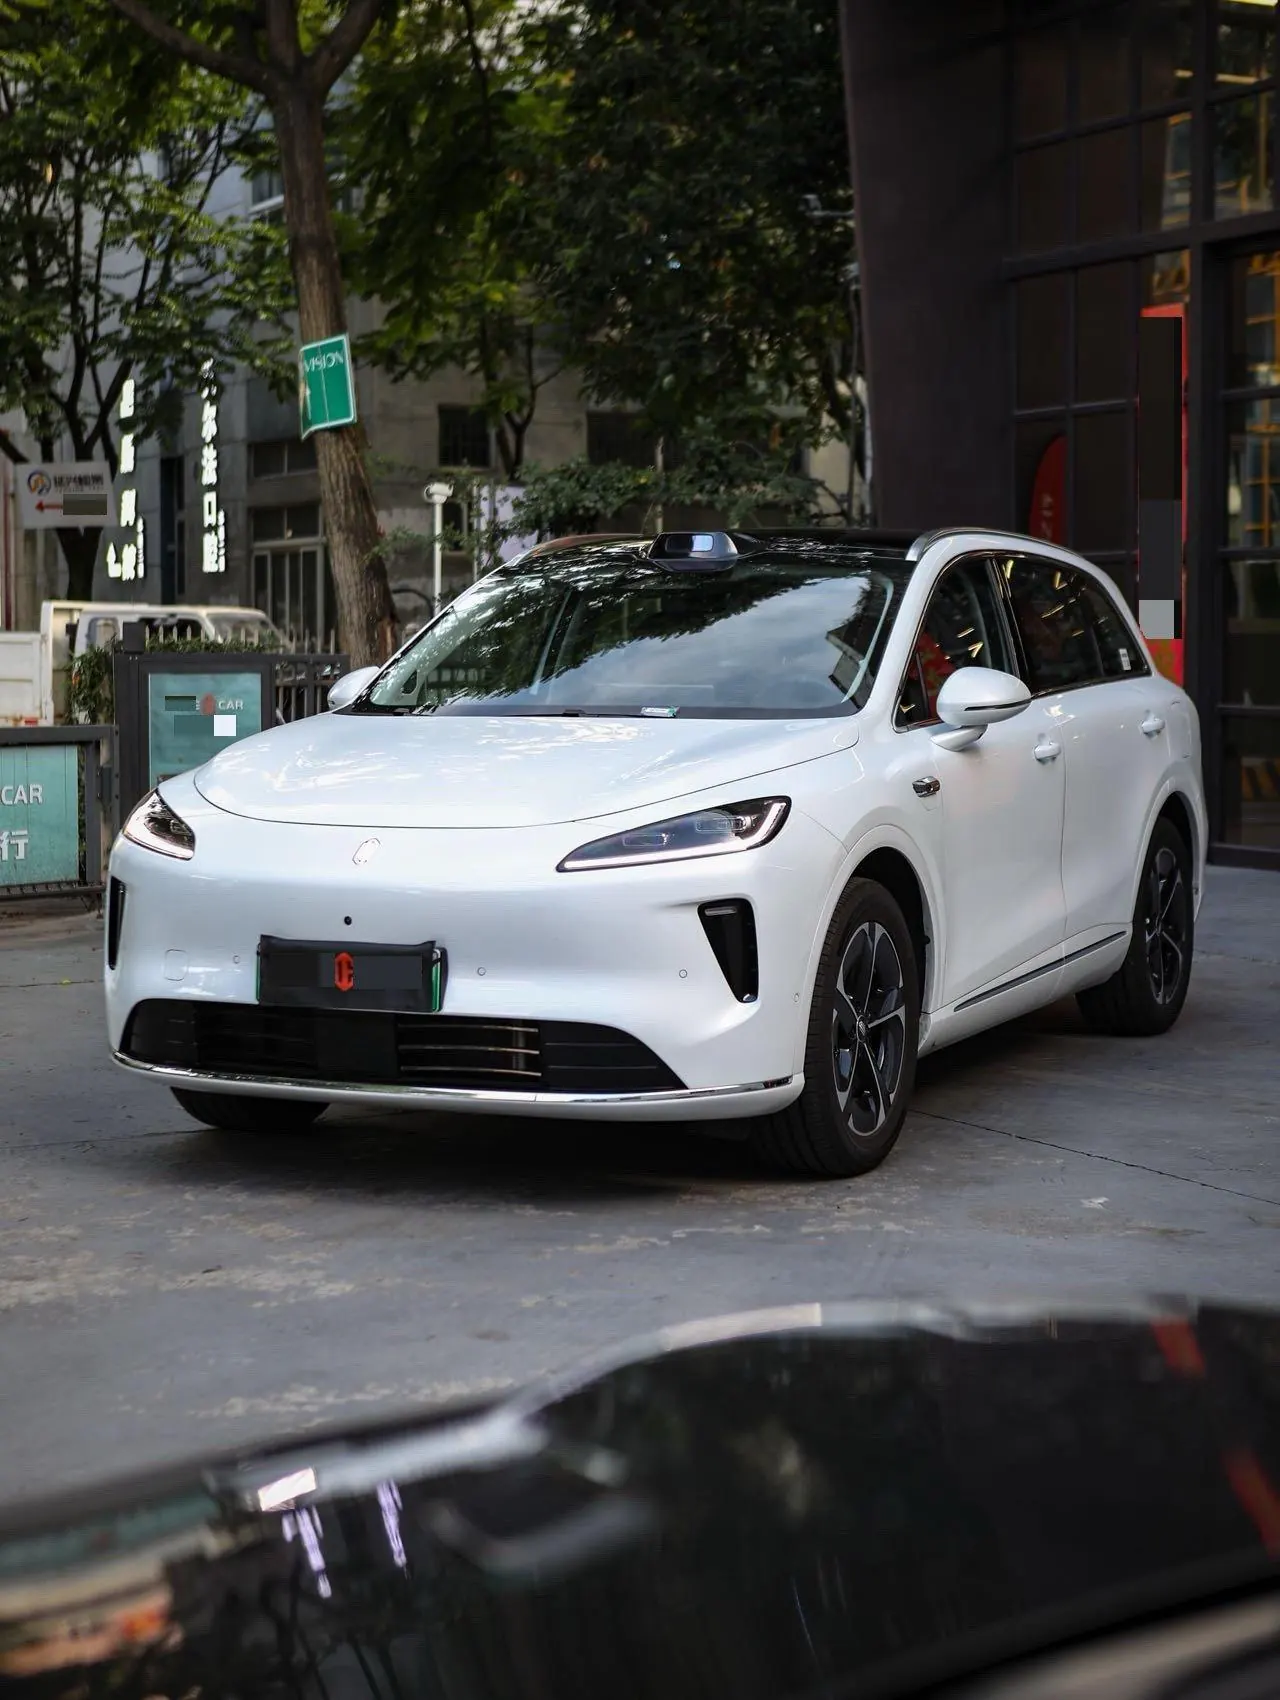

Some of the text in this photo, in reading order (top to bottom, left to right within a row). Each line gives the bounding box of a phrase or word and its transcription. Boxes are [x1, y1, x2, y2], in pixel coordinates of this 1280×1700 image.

[218, 699, 244, 711] CAR
[0, 783, 43, 806] CAR
[0, 830, 29, 861] 行
